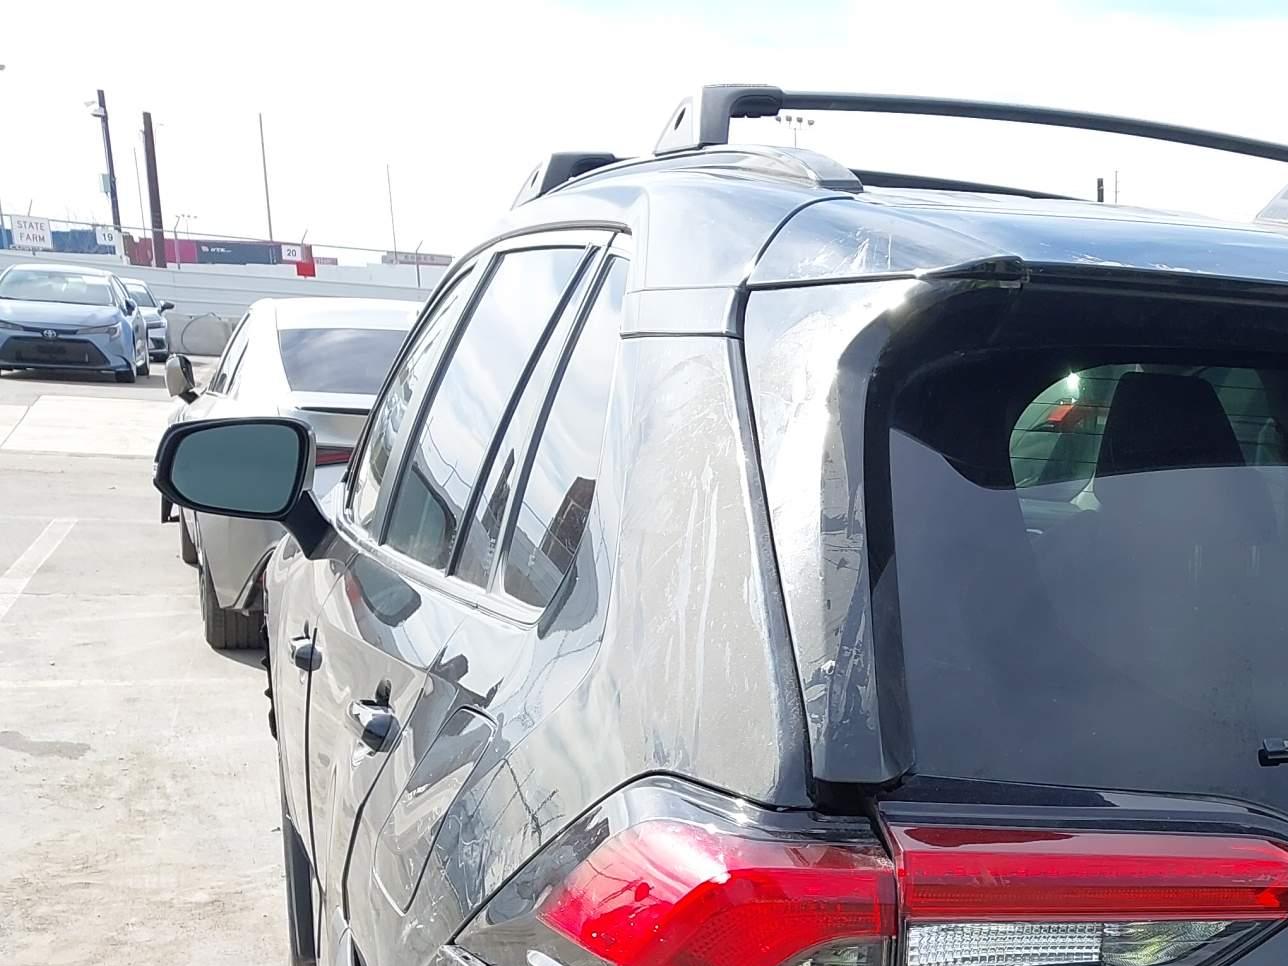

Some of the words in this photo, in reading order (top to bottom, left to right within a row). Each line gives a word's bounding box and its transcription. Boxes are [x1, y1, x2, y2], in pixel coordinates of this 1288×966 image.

[16, 219, 46, 232] STATE
[19, 232, 46, 243] FARM
[102, 233, 114, 242] 19
[286, 249, 297, 257] 20
